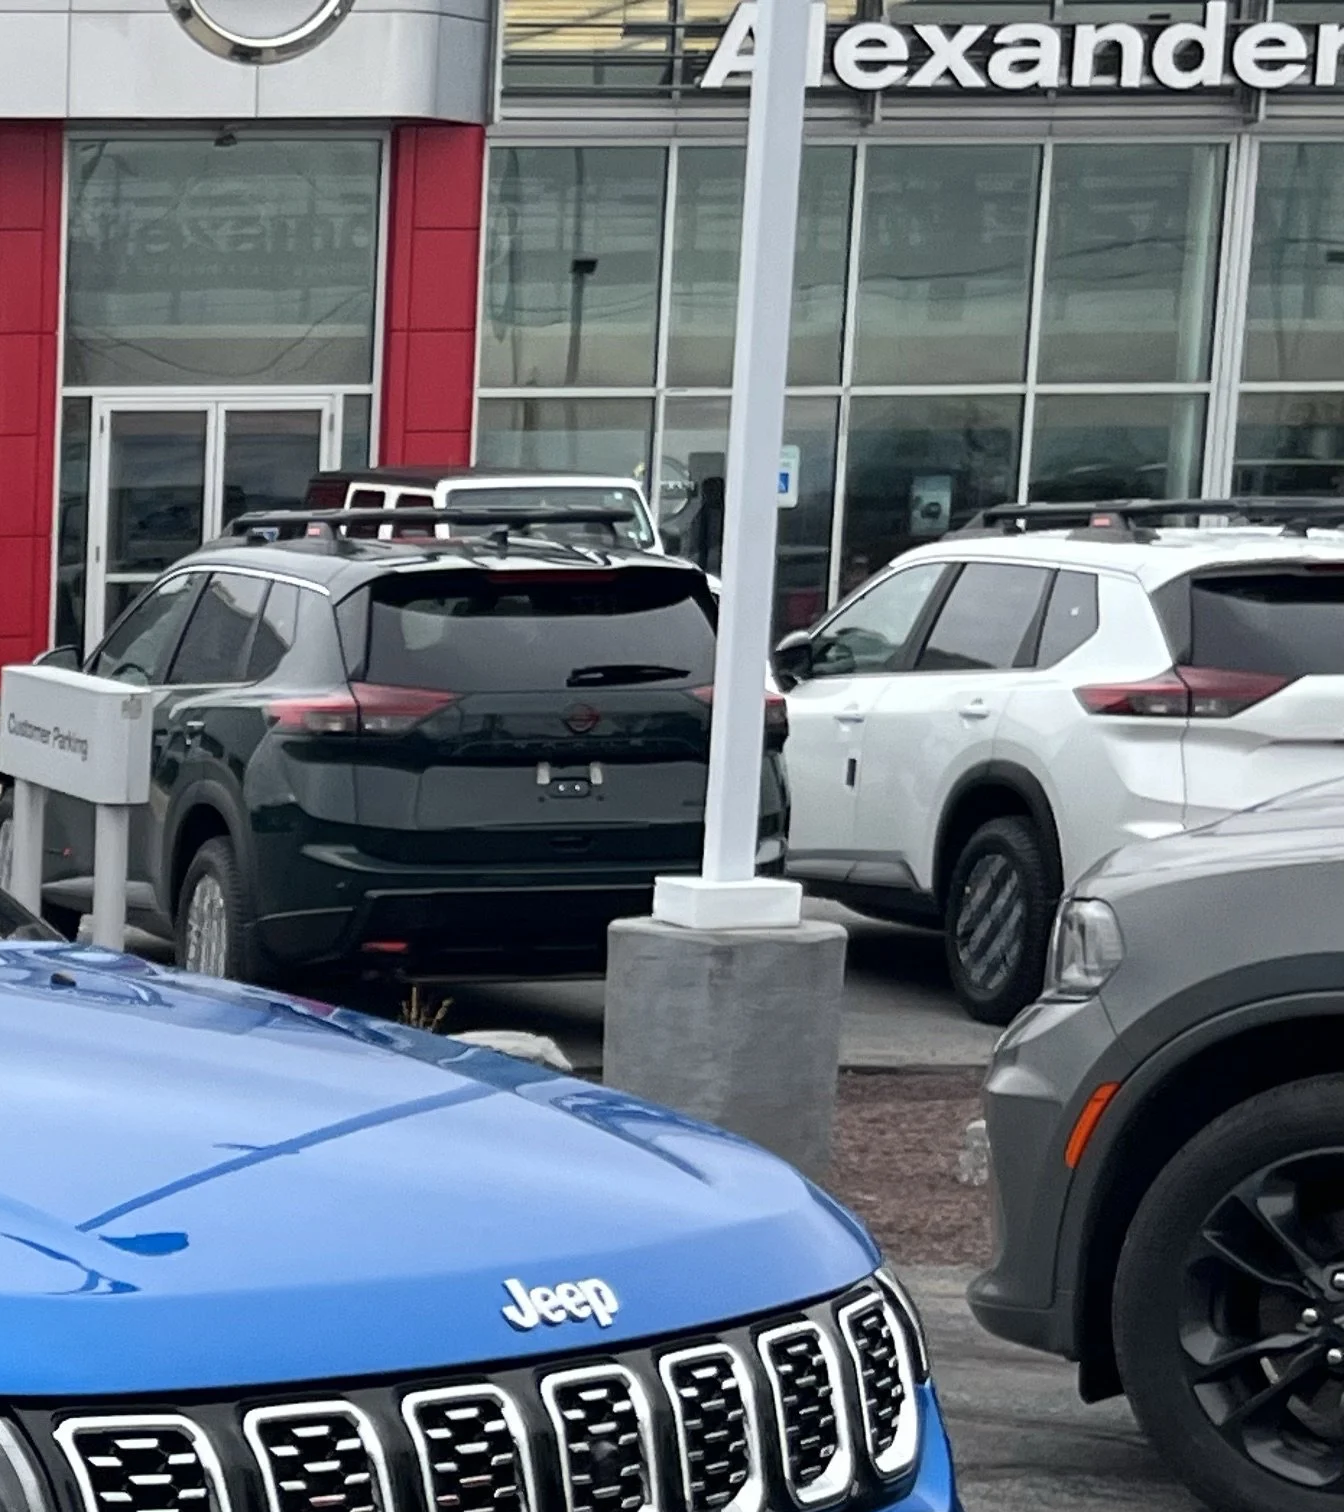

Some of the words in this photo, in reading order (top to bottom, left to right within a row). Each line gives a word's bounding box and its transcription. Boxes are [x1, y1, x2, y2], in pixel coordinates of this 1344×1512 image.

[7, 712, 51, 744] Customer
[52, 726, 89, 763] Parking
[501, 1278, 619, 1331] Jeep
